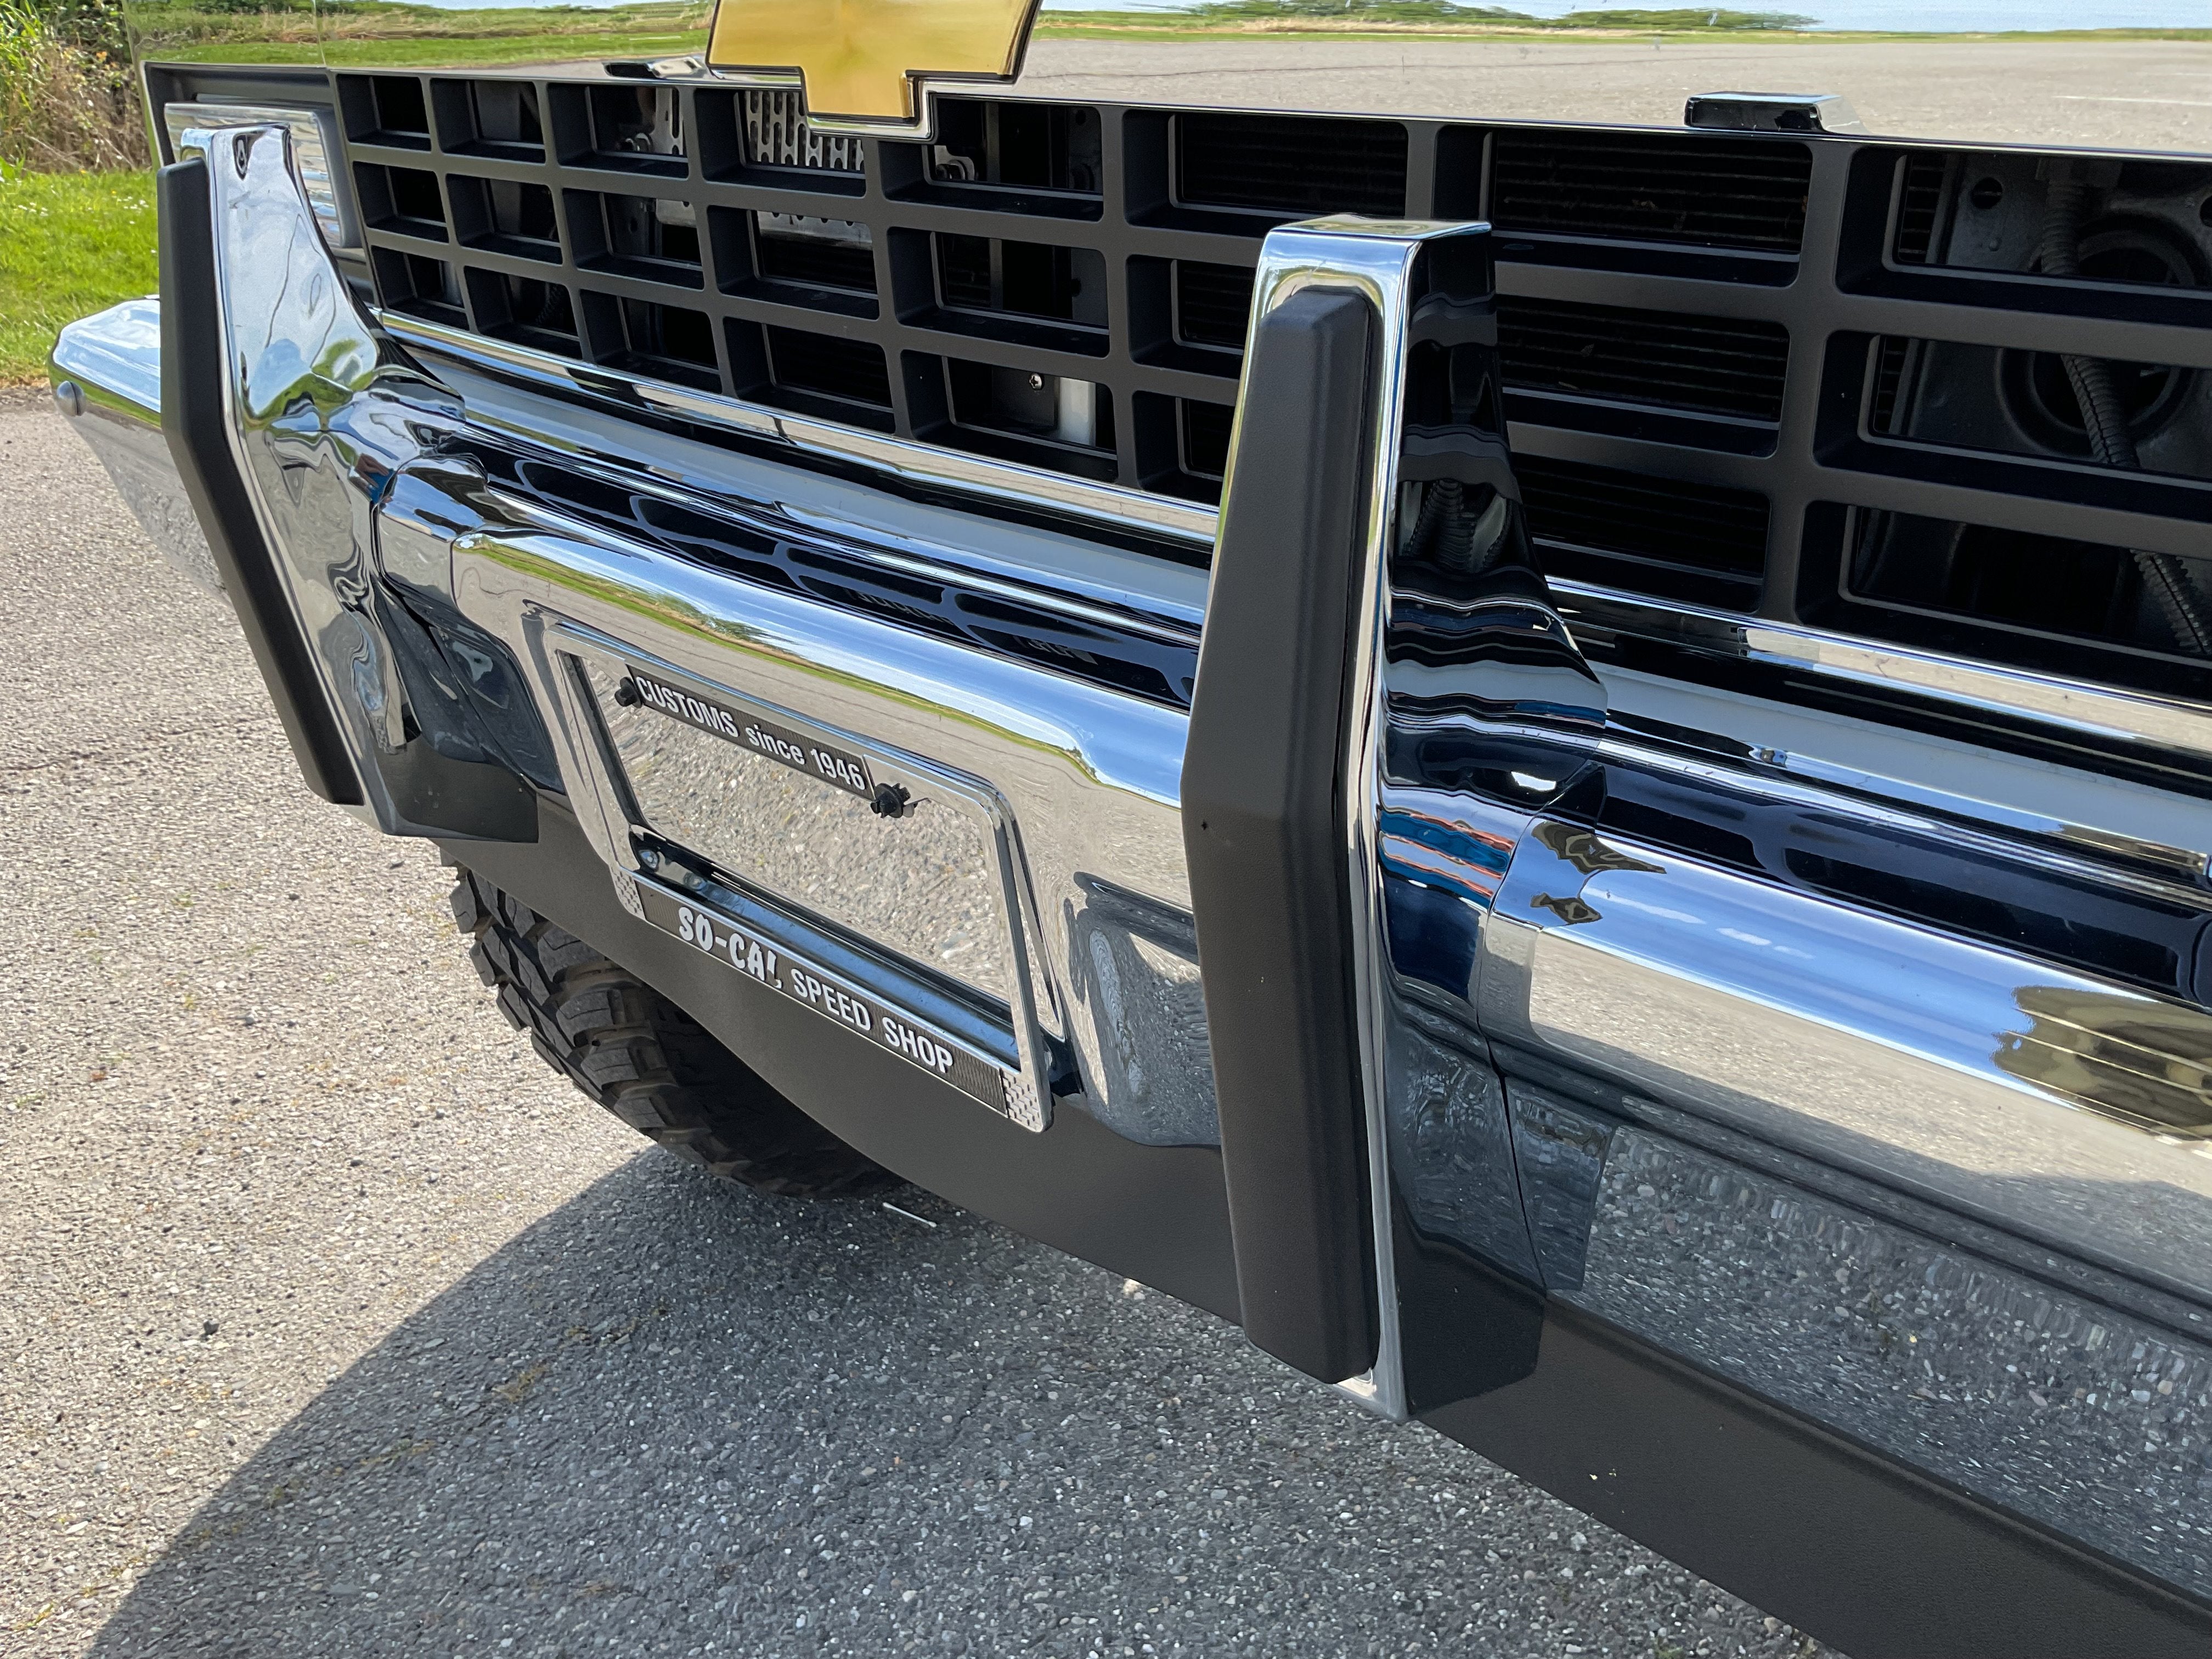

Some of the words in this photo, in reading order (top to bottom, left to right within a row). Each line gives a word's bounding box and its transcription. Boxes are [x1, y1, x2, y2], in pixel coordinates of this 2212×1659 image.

[635, 676, 738, 737] CUSTOMS
[746, 724, 805, 764] since
[810, 749, 866, 790] 1946
[679, 907, 783, 989] SO-CAL
[792, 968, 871, 1031] SPEED
[882, 1017, 953, 1073] SHOP
